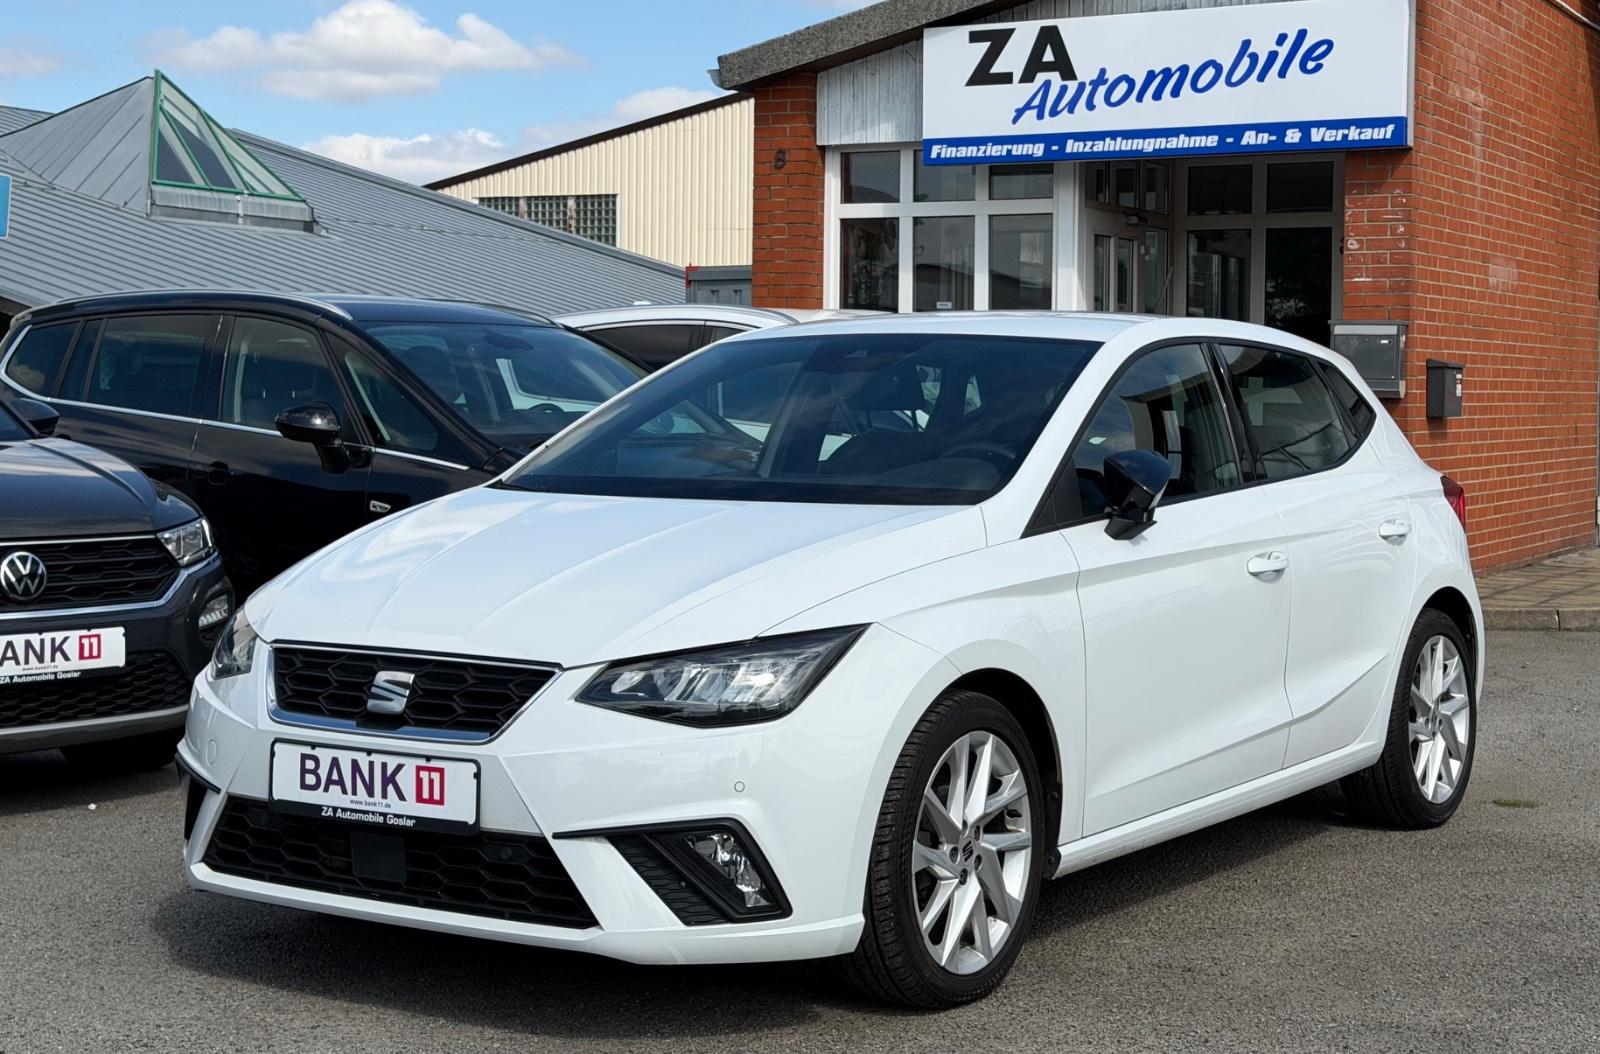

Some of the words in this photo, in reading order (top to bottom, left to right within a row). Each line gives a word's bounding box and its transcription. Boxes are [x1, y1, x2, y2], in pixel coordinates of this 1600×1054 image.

[965, 25, 1079, 87] ZA
[1011, 27, 1335, 125] Automobile
[929, 136, 1045, 160] Finanzierung
[1065, 133, 1219, 155] Inzahlungnahme
[1240, 130, 1277, 147] An-
[1284, 128, 1302, 144] &
[1310, 123, 1396, 143] Verkauf
[81, 637, 98, 658] 11
[12, 672, 55, 684] Automobile
[57, 671, 82, 680] Goslar
[299, 752, 407, 802] BANK
[419, 770, 441, 801] 11
[321, 806, 334, 818] ZA
[336, 808, 384, 824] Automobile
[386, 814, 416, 828] Goslar
[349, 798, 392, 810] www.bank11.de
